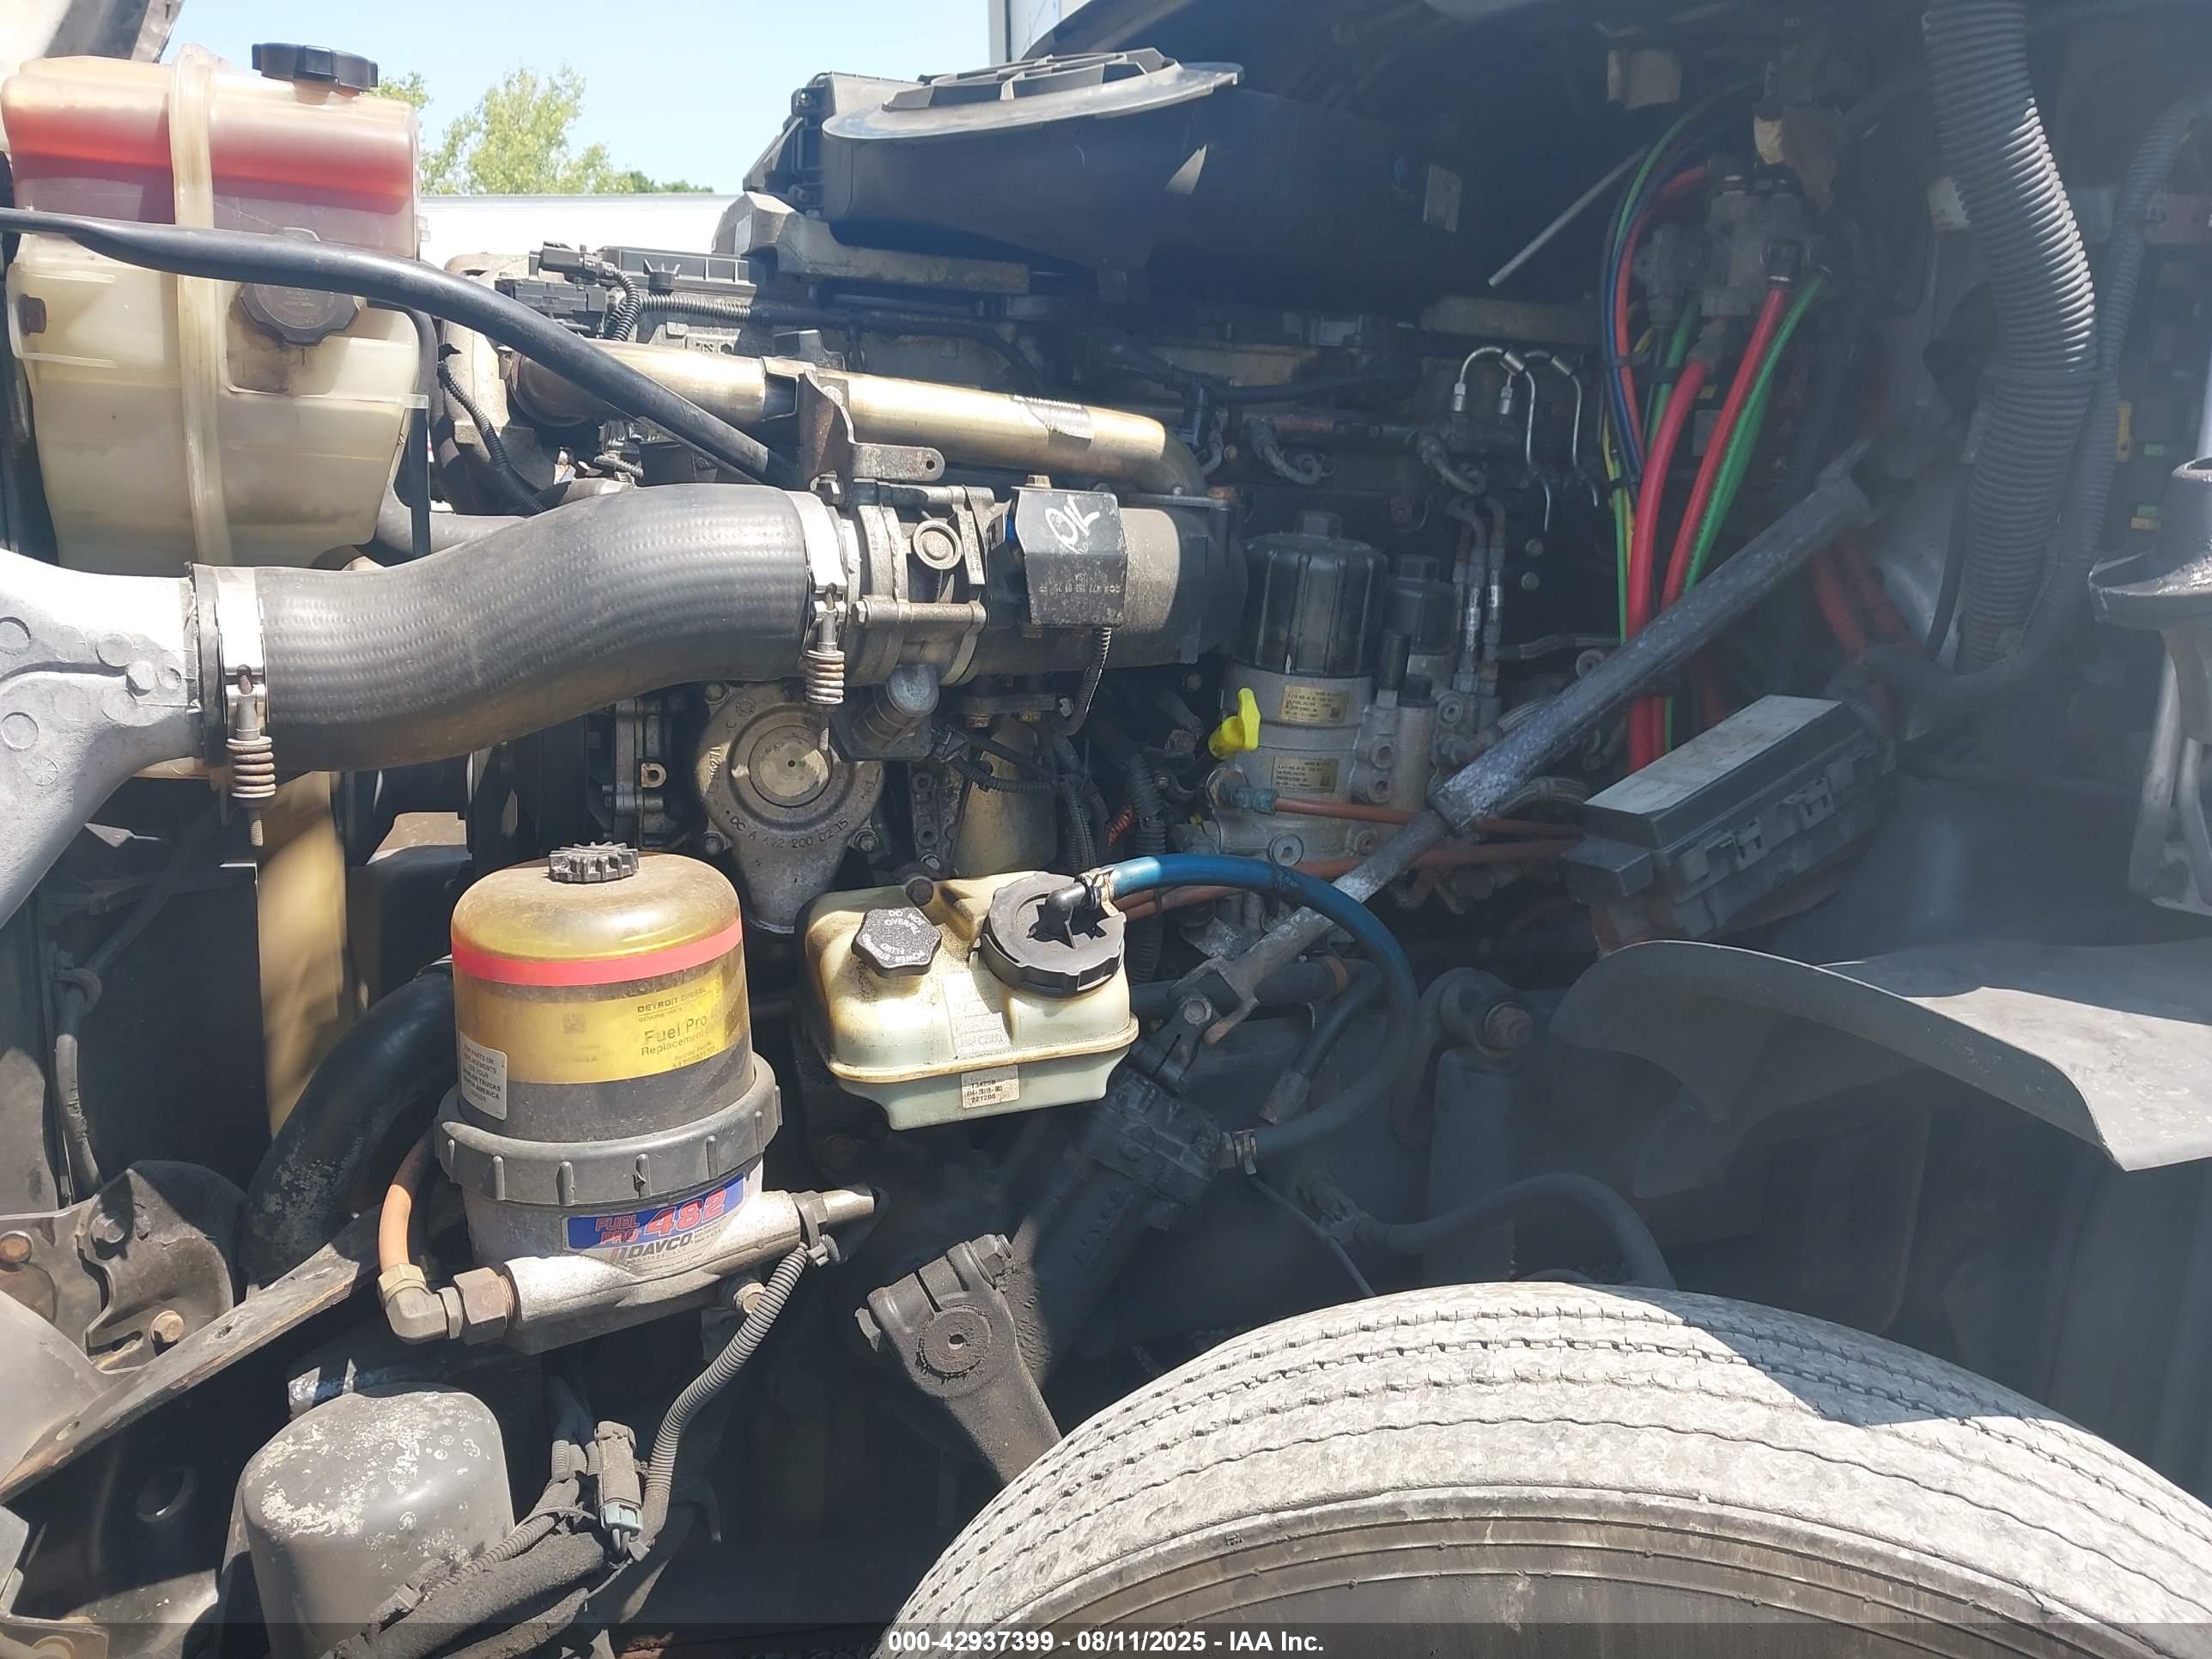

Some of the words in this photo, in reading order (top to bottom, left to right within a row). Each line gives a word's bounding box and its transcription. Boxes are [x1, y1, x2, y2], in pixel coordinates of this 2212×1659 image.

[1045, 494, 1100, 555] OK
[791, 837, 814, 848] 200
[818, 830, 834, 842] 02
[884, 919, 921, 935] OVERFILL
[908, 913, 927, 926] NOT
[861, 933, 890, 961] STEERING
[880, 943, 905, 955] FLUID
[895, 950, 926, 963] POWER
[637, 997, 678, 1012] DETROIT
[638, 1013, 665, 1023] GENUINE
[644, 1023, 681, 1043] Fuel
[686, 1015, 708, 1033] Pro
[479, 1077, 501, 1091] TRUCKS
[476, 1085, 500, 1099] AMERICA
[643, 1188, 726, 1237] 482
[595, 1214, 640, 1231] FUEL
[600, 1230, 639, 1244] PRO
[628, 1232, 693, 1259] DAVCO
